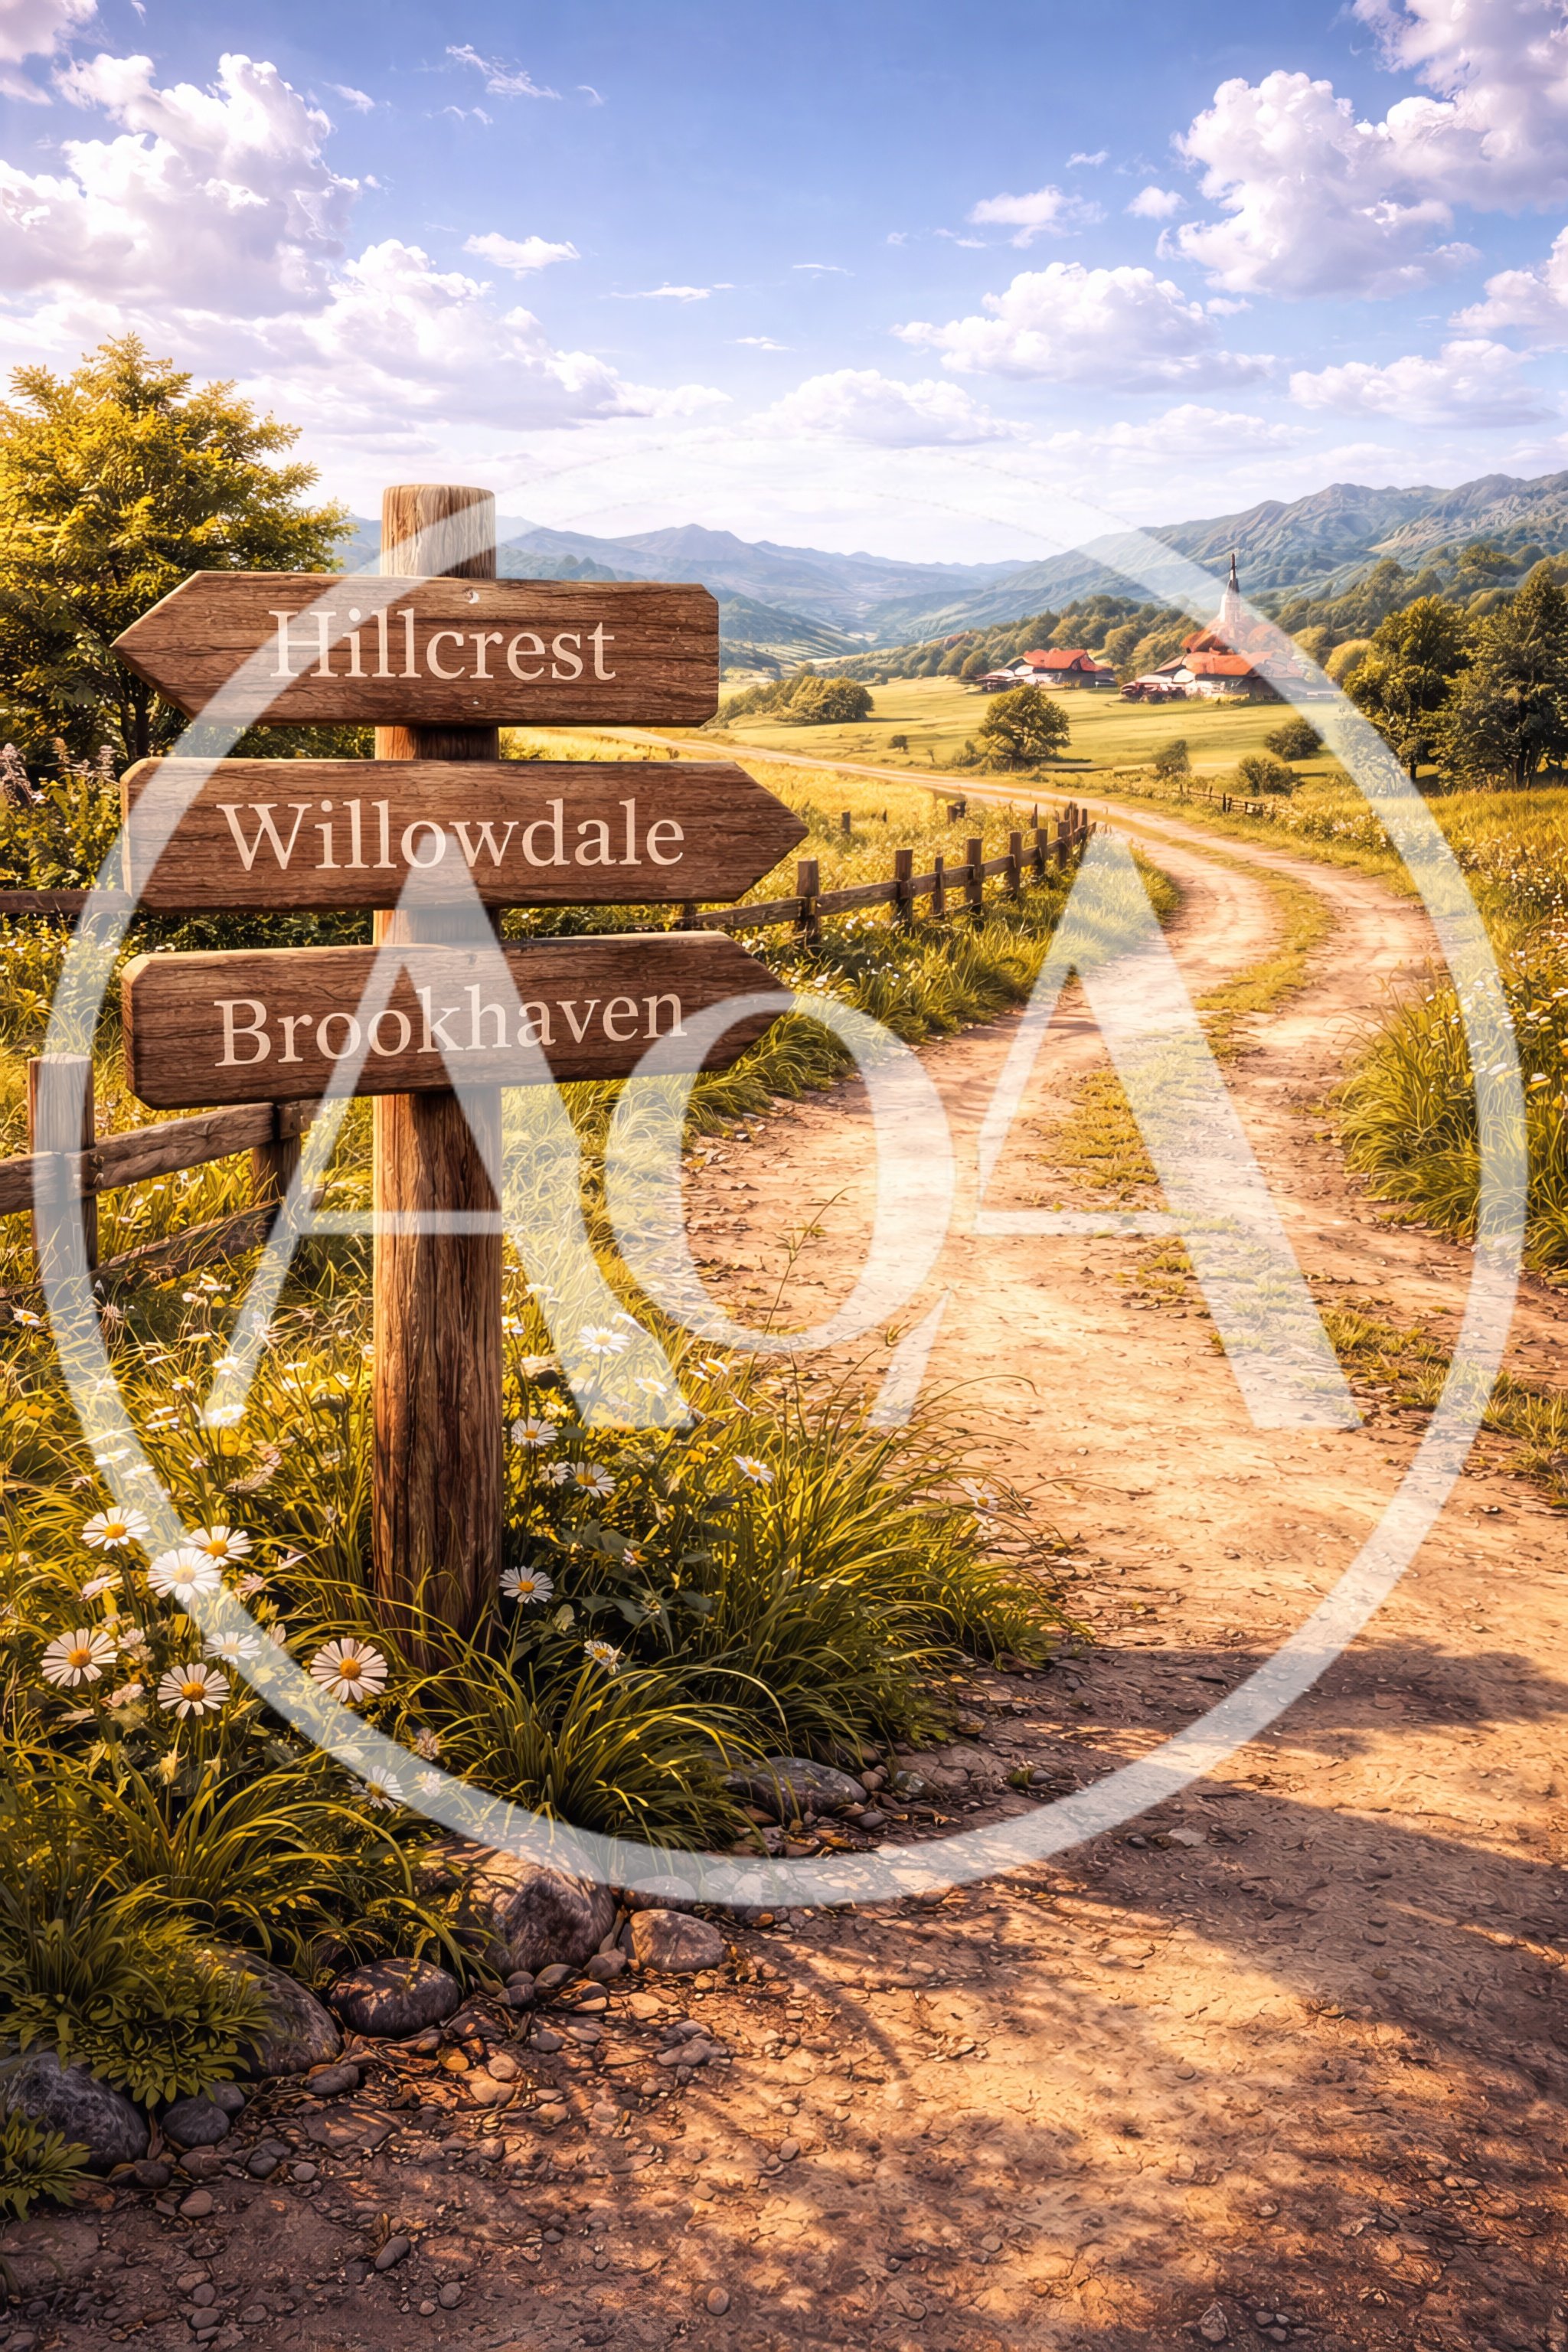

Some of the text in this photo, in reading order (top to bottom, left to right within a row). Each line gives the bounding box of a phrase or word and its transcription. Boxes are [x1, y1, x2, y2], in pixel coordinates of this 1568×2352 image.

[268, 607, 617, 681] Hillcrest
[216, 798, 685, 871] Willowdale
[214, 983, 688, 1067] Brookhaven
